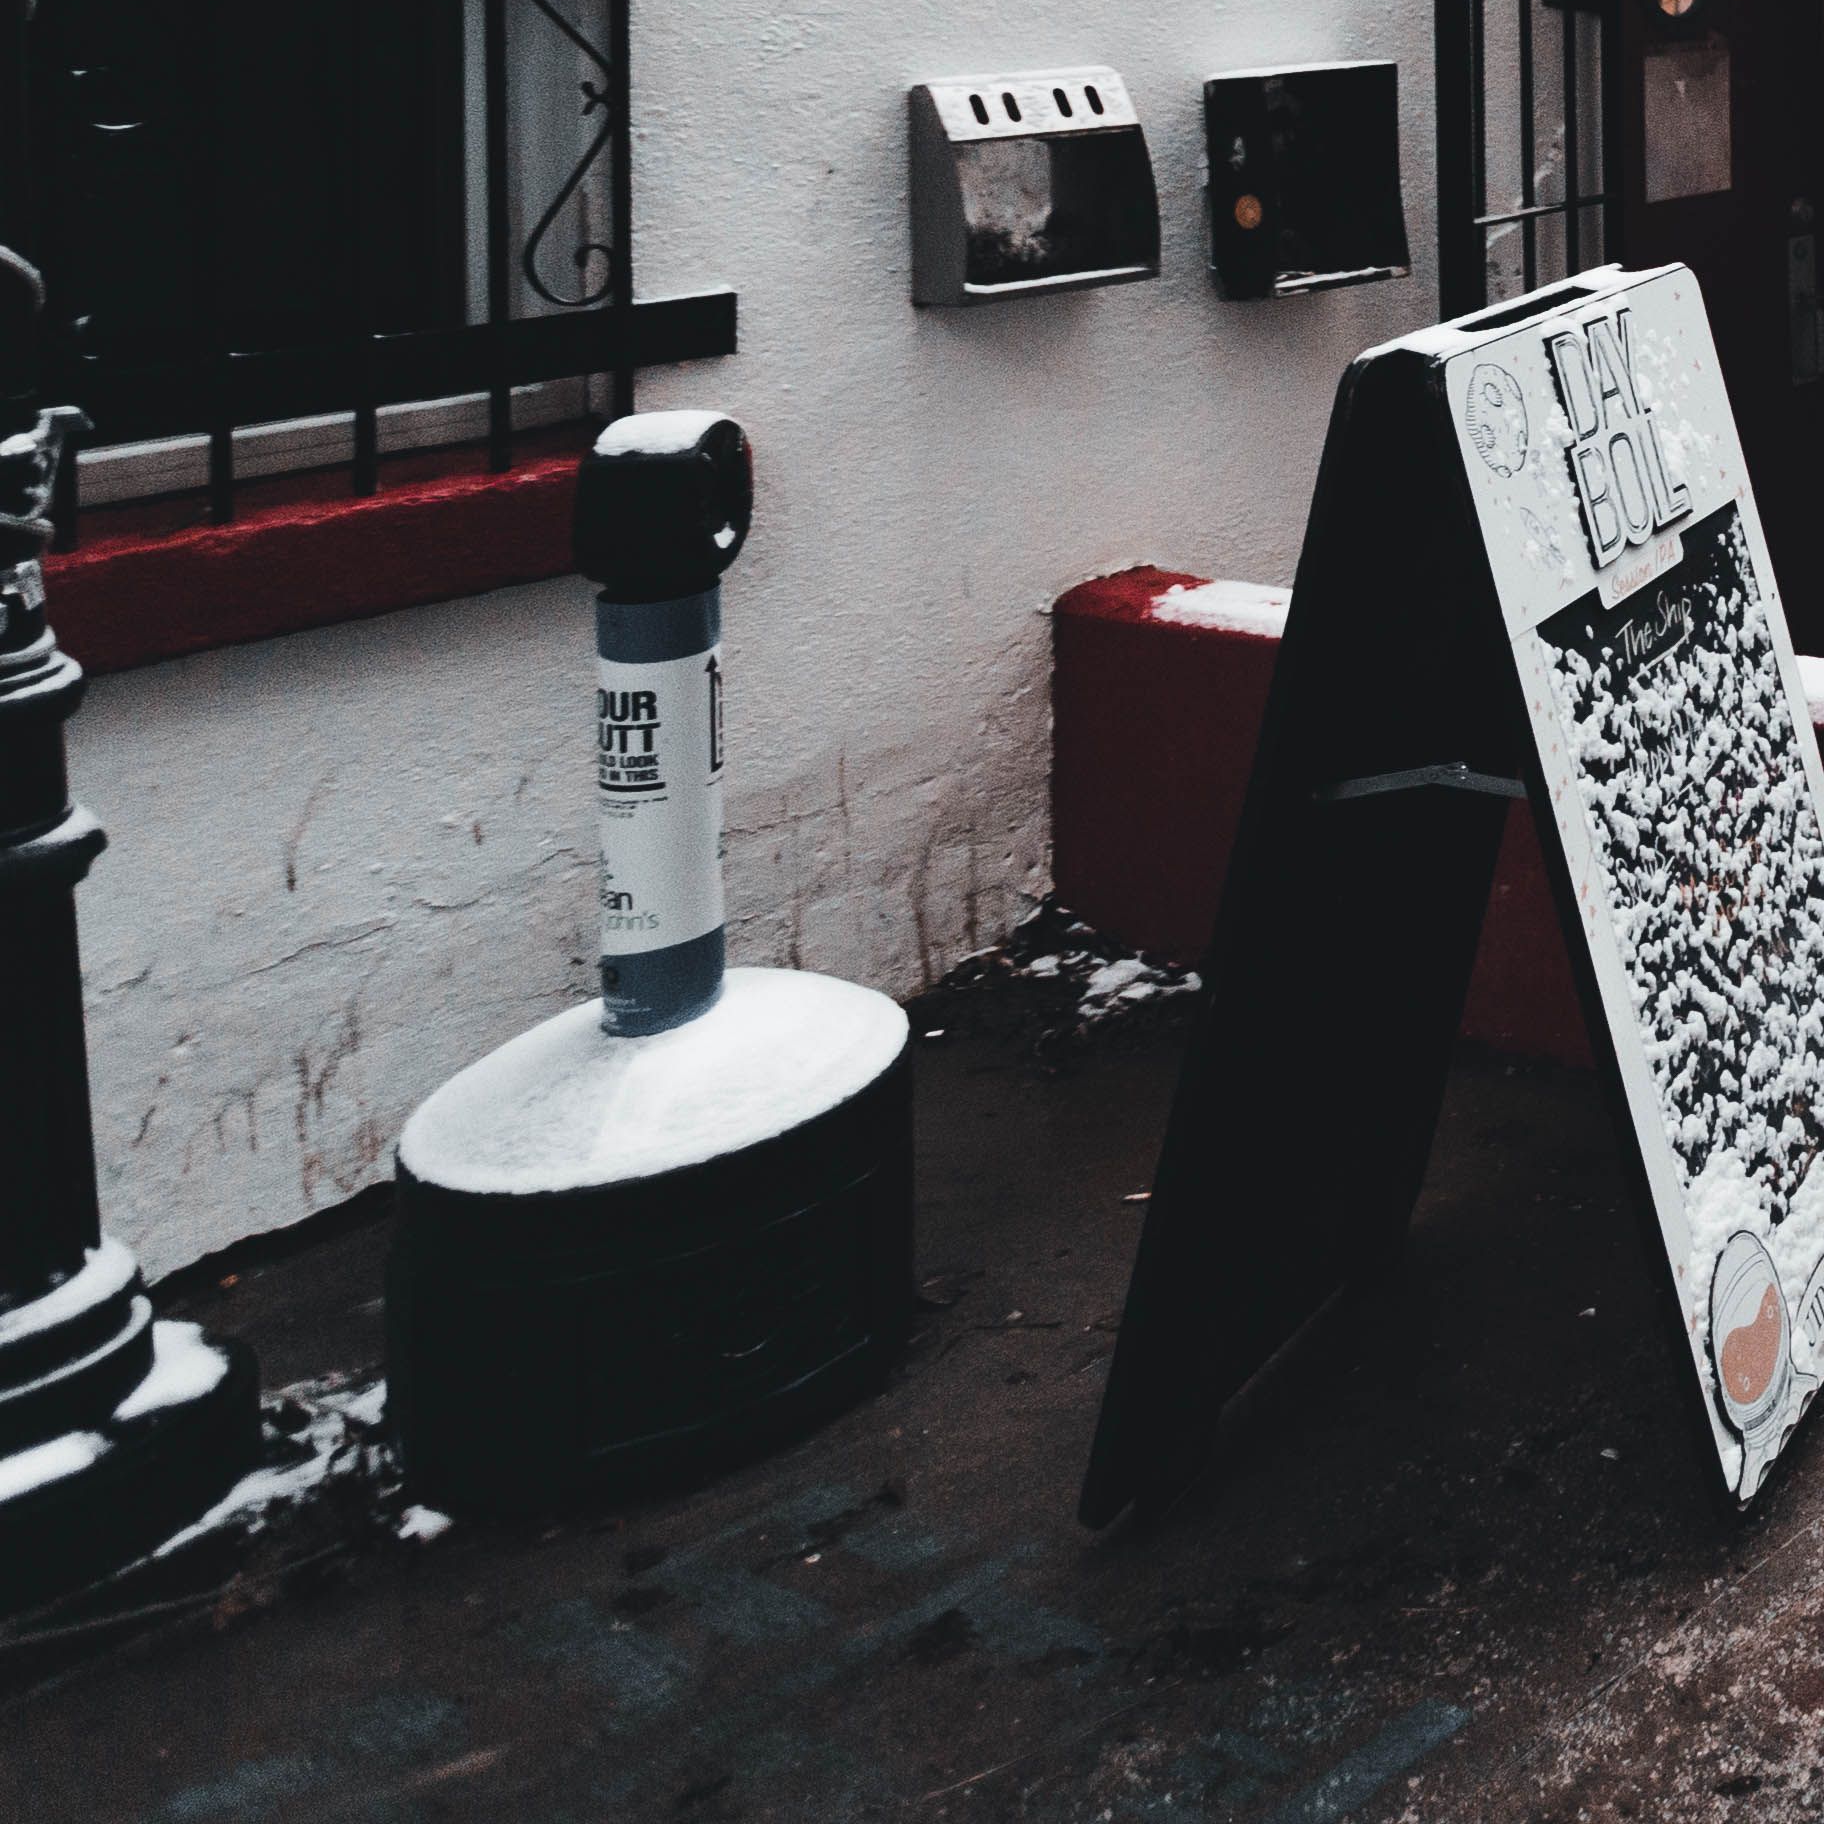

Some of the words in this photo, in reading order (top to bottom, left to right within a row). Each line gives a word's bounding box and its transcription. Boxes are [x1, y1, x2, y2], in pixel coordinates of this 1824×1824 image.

[1542, 307, 1651, 444] DAY
[1655, 538, 1677, 572] IPA
[1614, 618, 1653, 665] The
[1655, 590, 1693, 645] Ship
[597, 688, 658, 722] OUR
[599, 722, 662, 754] UTT
[624, 768, 659, 783] THIS
